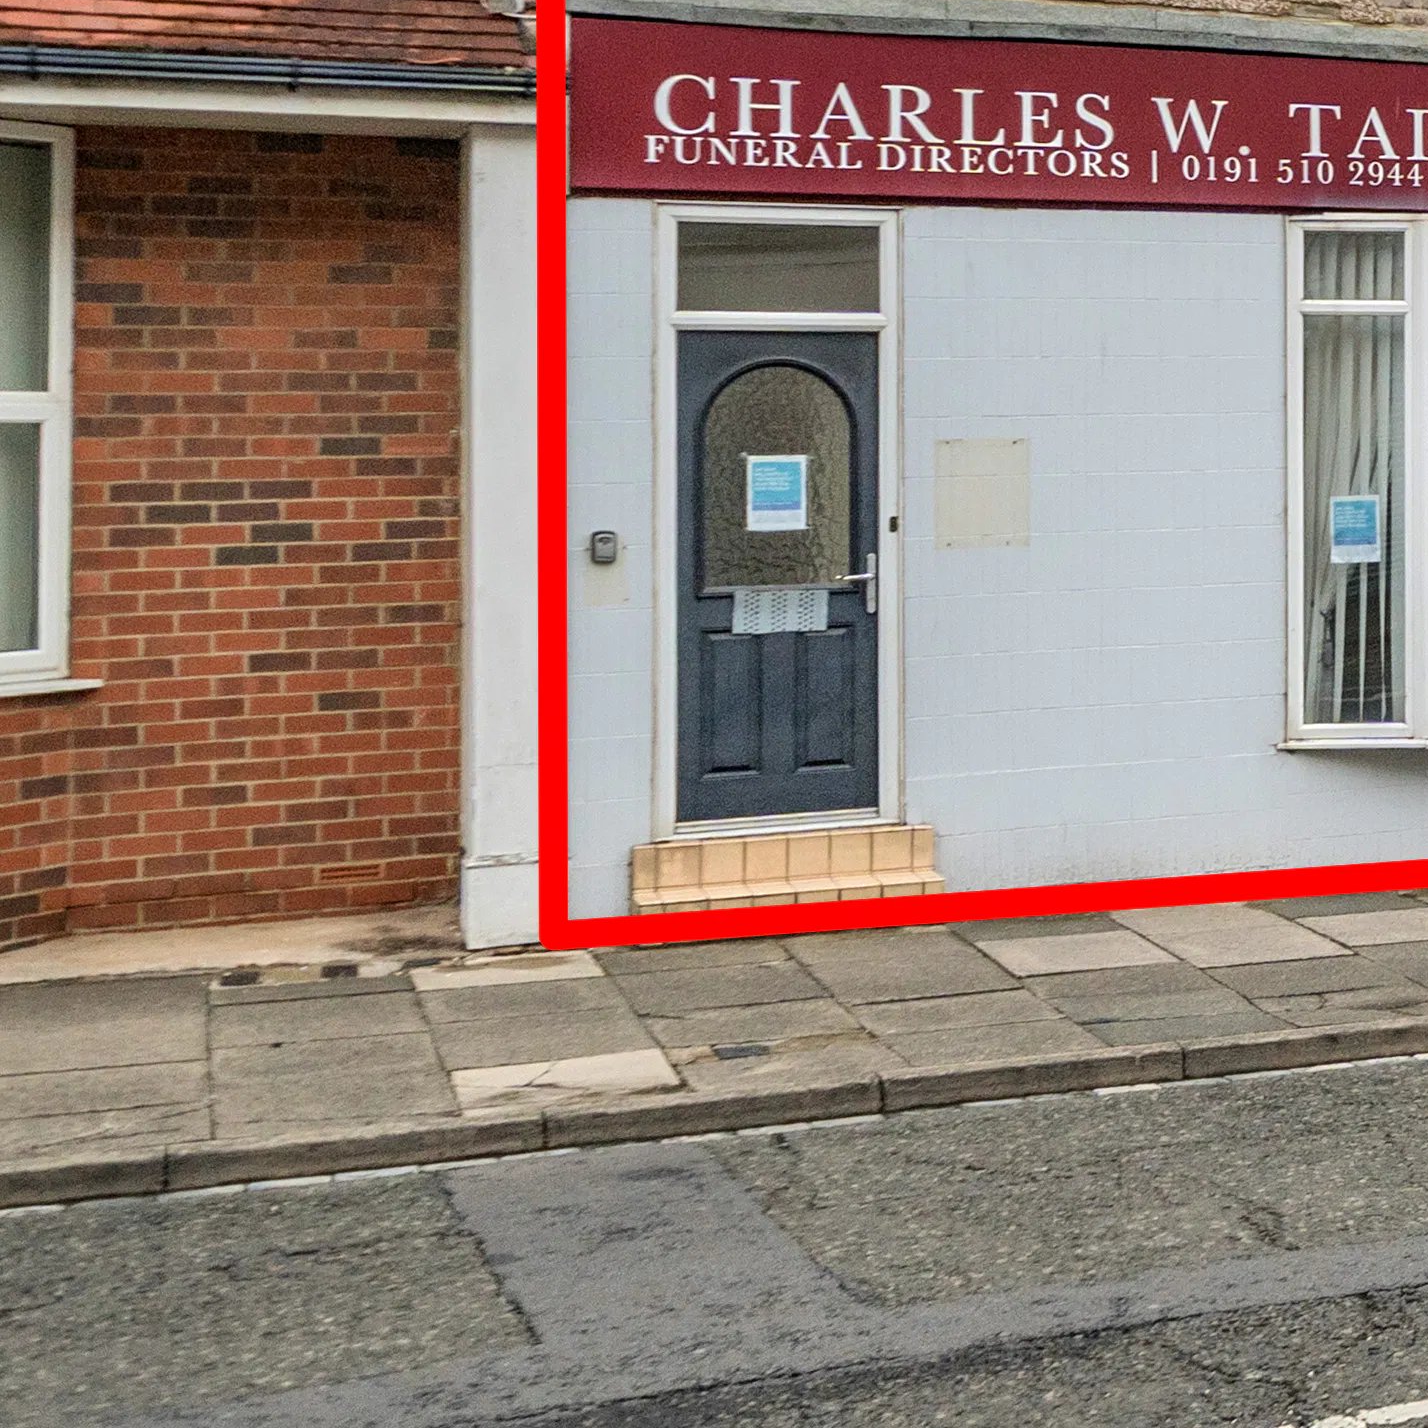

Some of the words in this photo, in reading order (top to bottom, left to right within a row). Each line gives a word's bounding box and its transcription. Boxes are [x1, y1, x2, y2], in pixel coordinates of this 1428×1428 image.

[654, 74, 1115, 150] CHARLES
[1150, 97, 1251, 156] W.
[643, 134, 863, 170] FUNERAL
[876, 143, 1130, 179] DIRECTORS
[1182, 154, 1258, 183] 0191
[1276, 159, 1334, 185] 510
[1348, 160, 1424, 187] 2944
